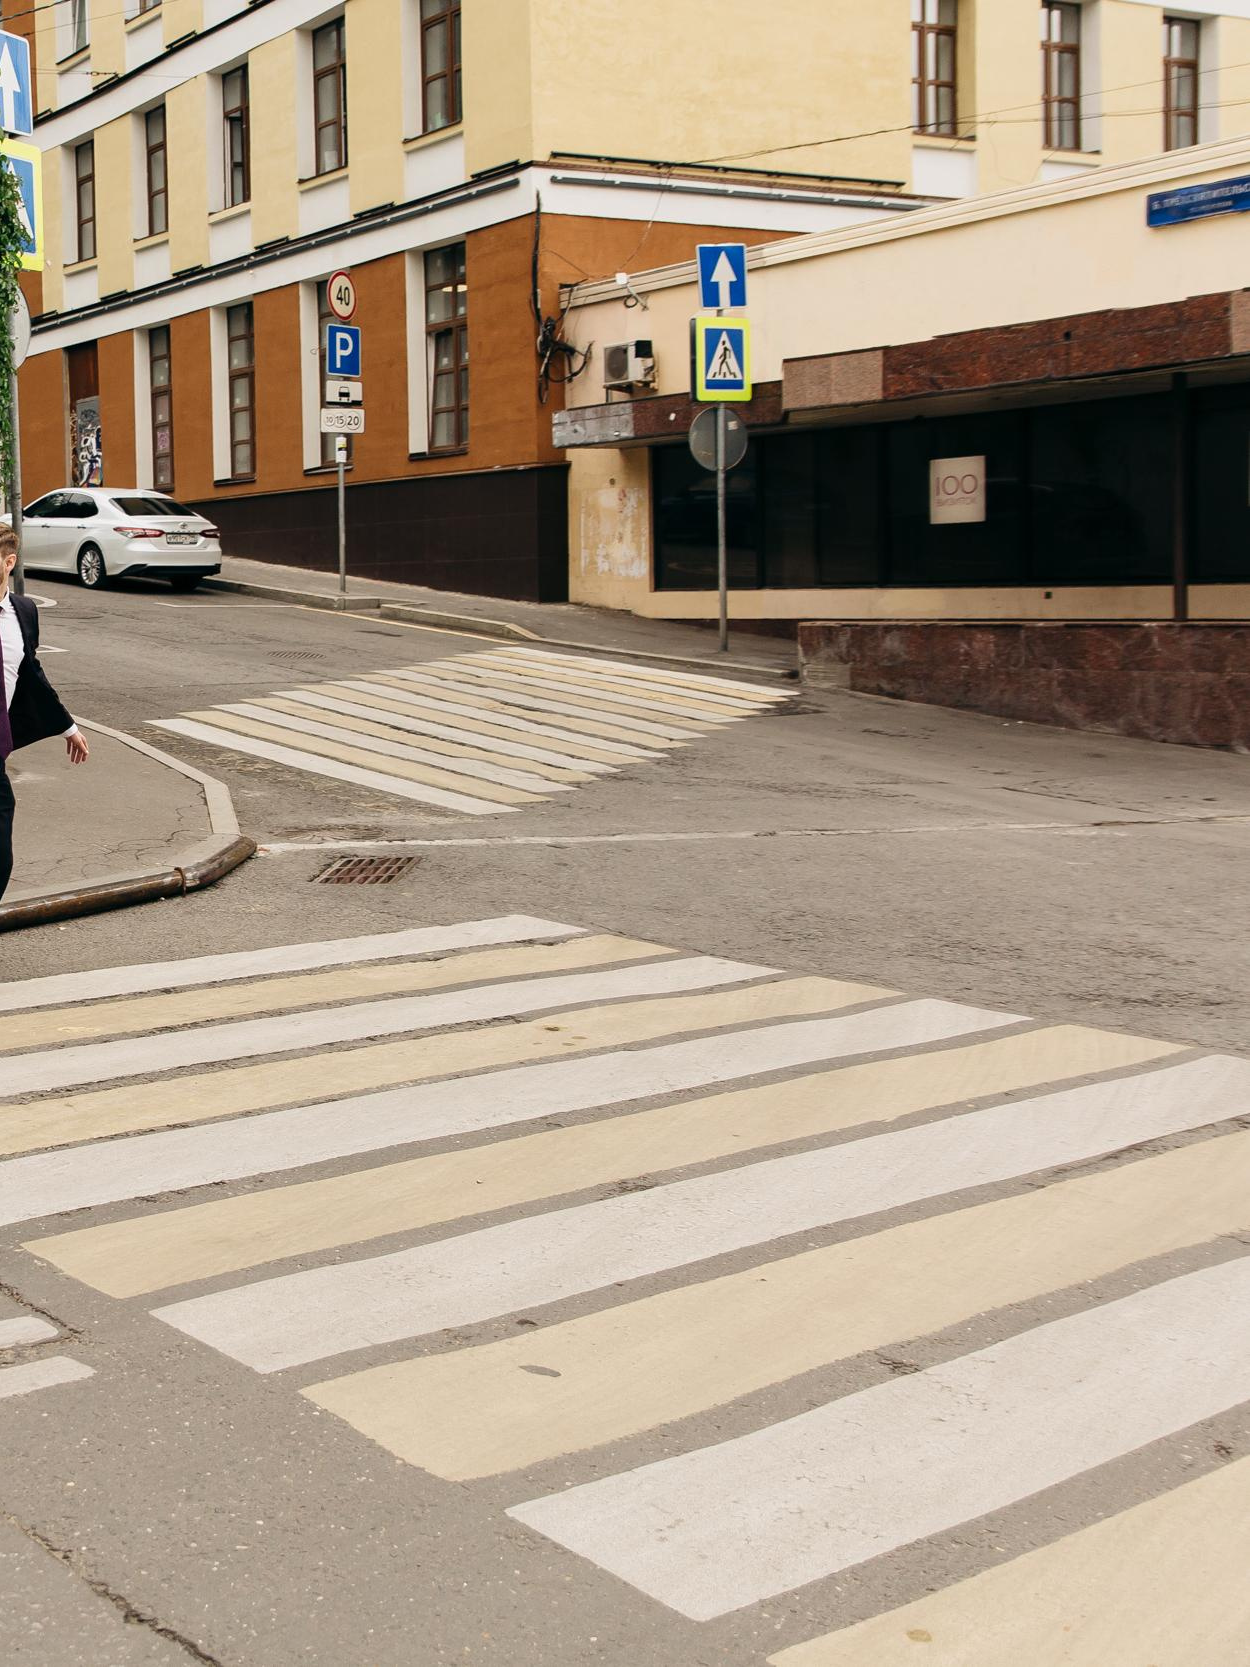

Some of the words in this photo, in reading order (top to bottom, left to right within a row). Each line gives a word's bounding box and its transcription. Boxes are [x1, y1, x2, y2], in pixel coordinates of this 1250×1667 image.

[336, 285, 350, 306] 40
[336, 332, 353, 368] P
[335, 415, 344, 425] 15
[347, 415, 359, 426] 20
[935, 474, 978, 496] 100
